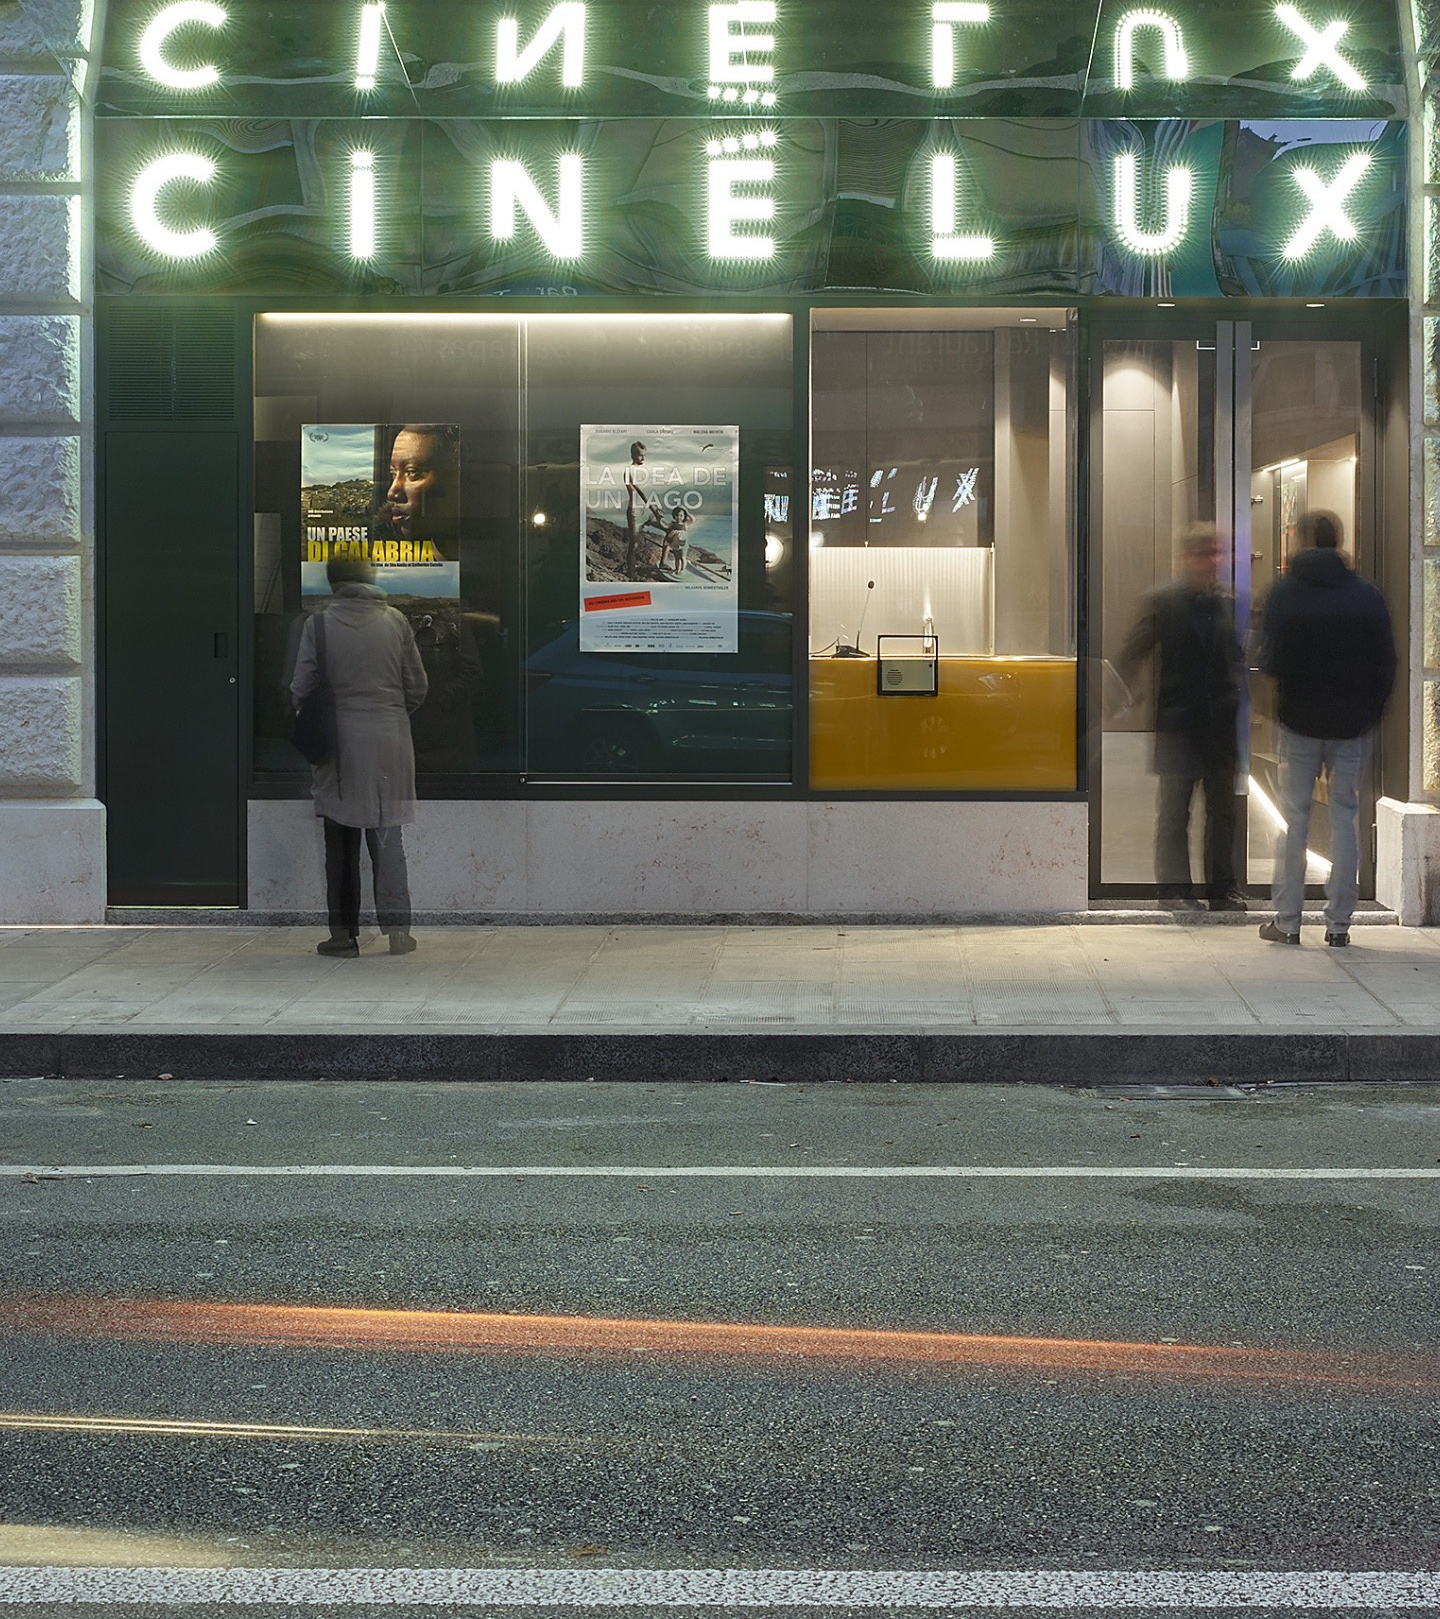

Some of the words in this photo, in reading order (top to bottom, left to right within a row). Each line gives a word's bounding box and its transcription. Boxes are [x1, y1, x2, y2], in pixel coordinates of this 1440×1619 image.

[586, 466, 616, 485] LA
[625, 466, 685, 485] IDEA
[693, 466, 727, 486] DE
[586, 490, 622, 510] UN
[632, 490, 704, 510] LAGO
[307, 526, 326, 542] UN
[328, 526, 368, 542] PAESE
[308, 540, 329, 562] DI
[334, 540, 436, 562] CALABRIA
